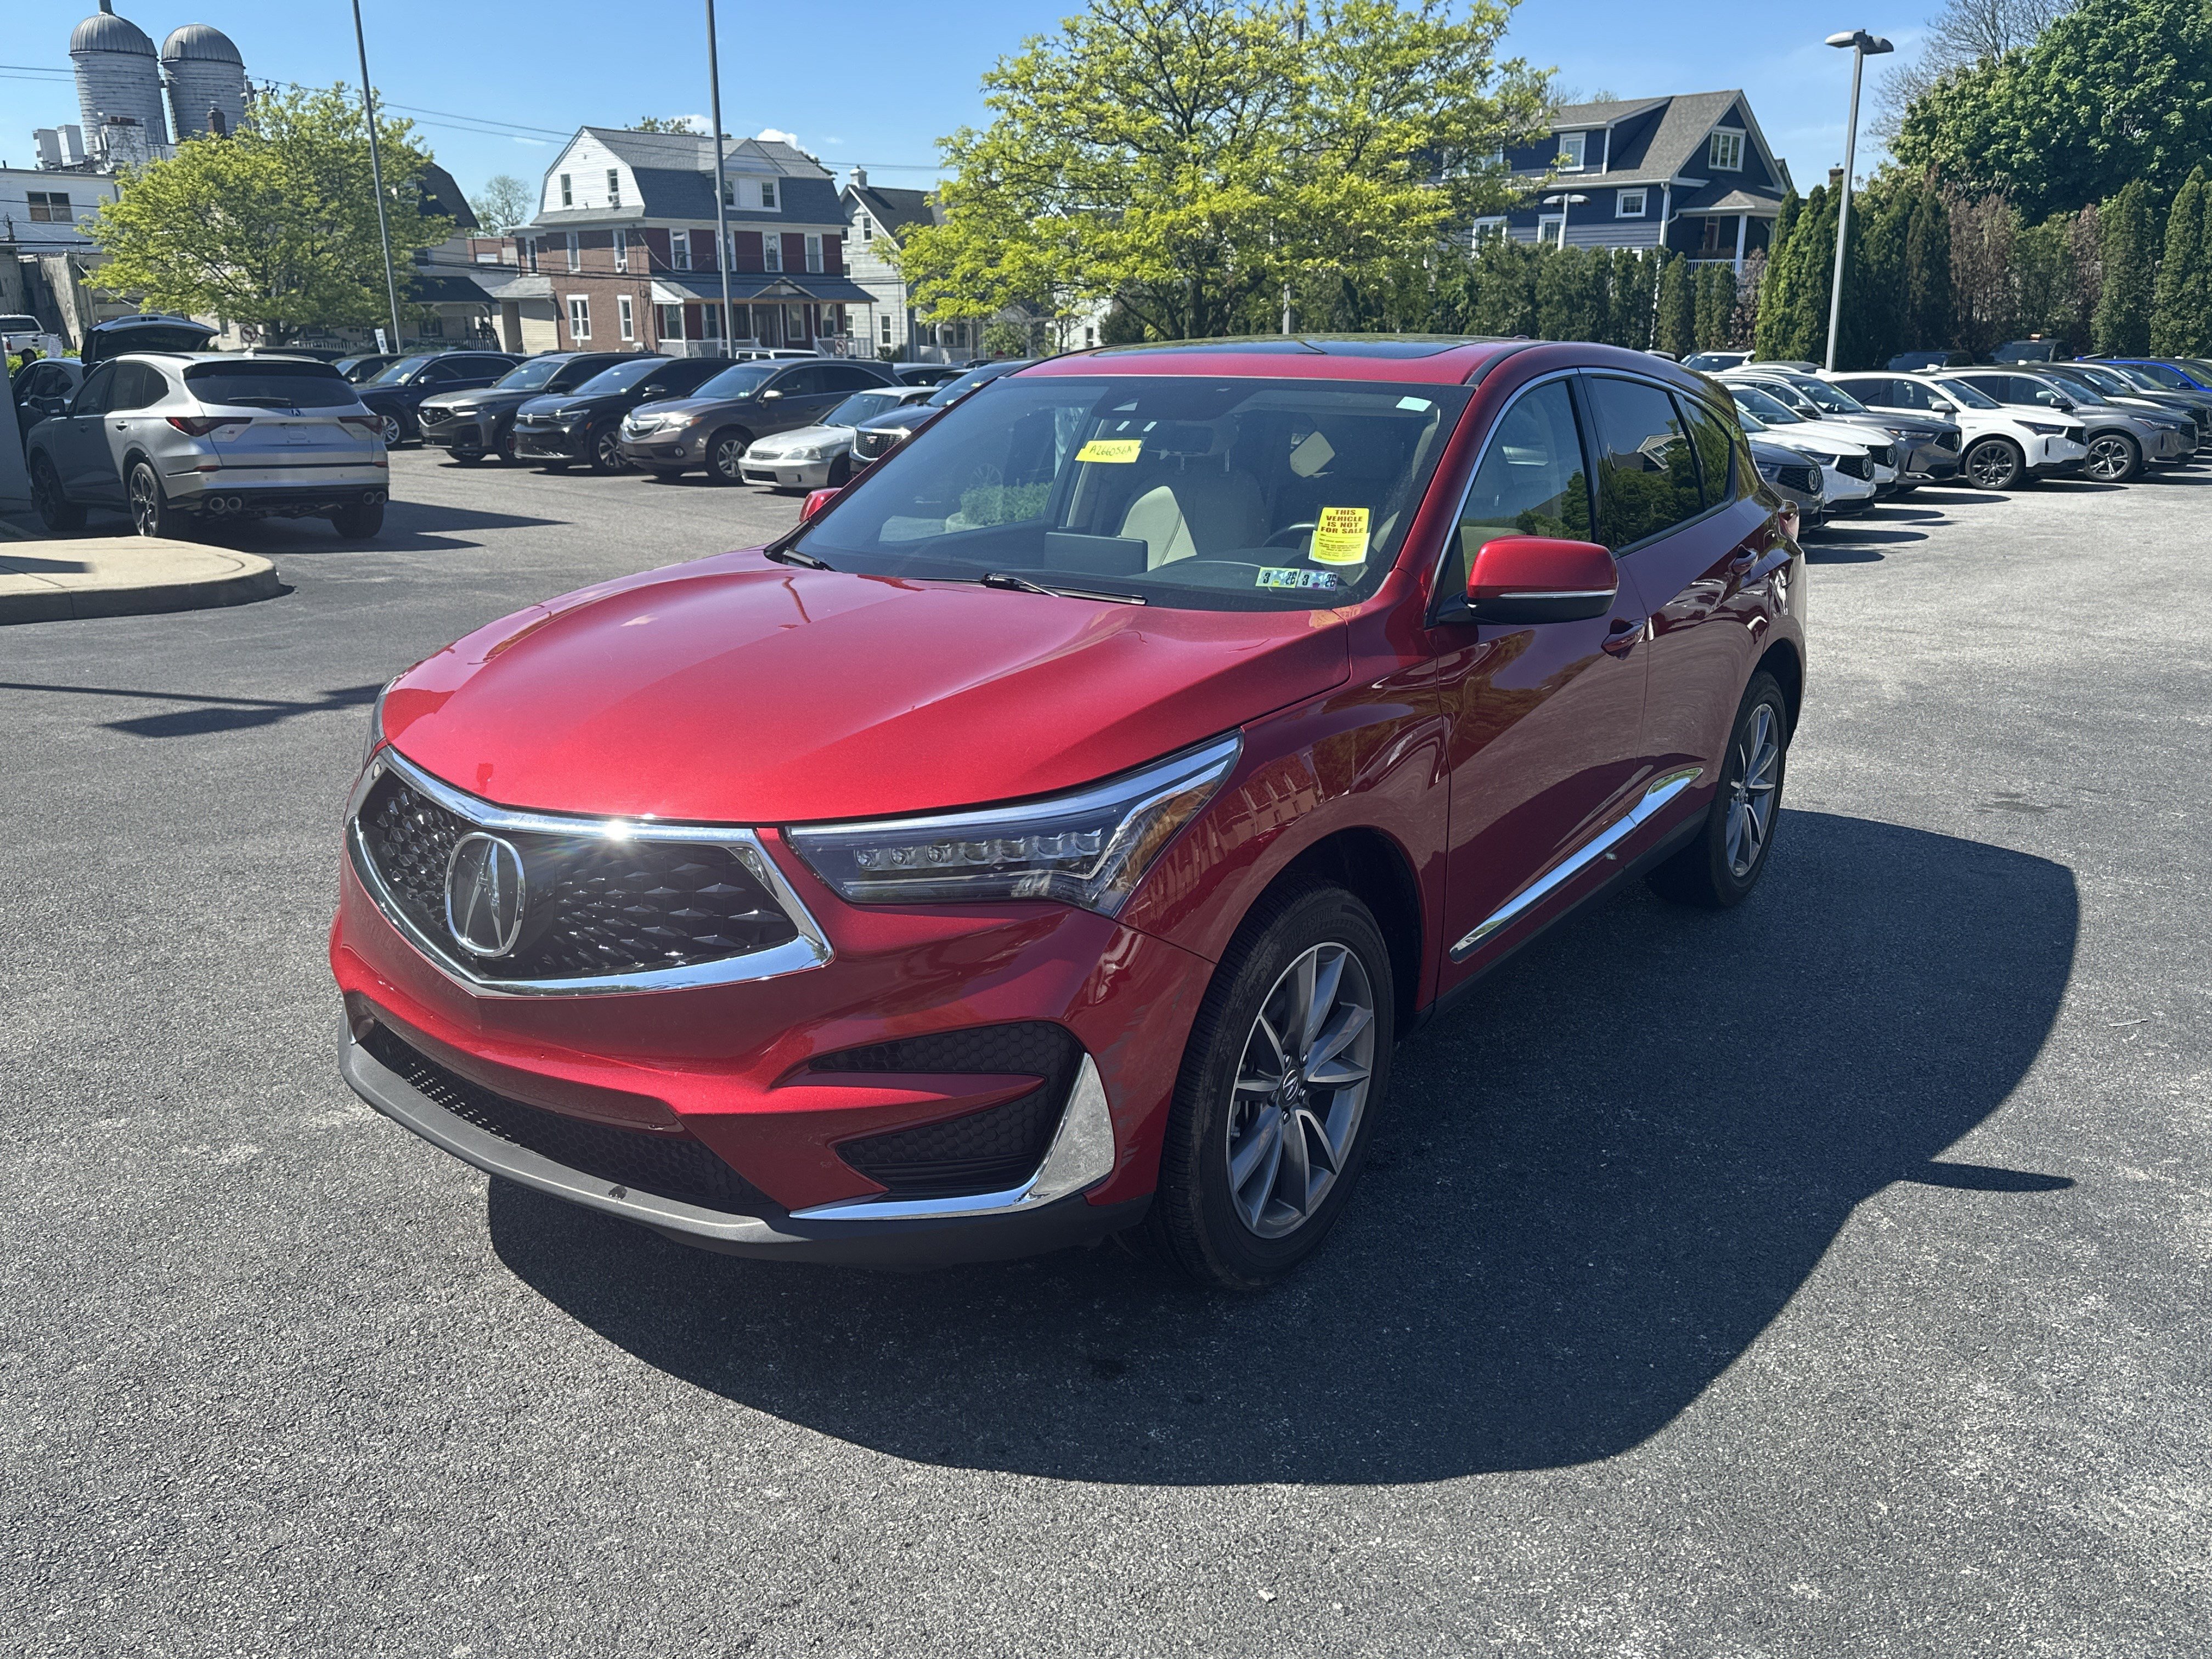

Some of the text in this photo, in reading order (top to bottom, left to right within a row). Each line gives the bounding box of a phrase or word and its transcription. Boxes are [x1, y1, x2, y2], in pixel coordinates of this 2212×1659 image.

[1263, 572, 1297, 584] 3 26
[1302, 574, 1337, 587] 3 26
